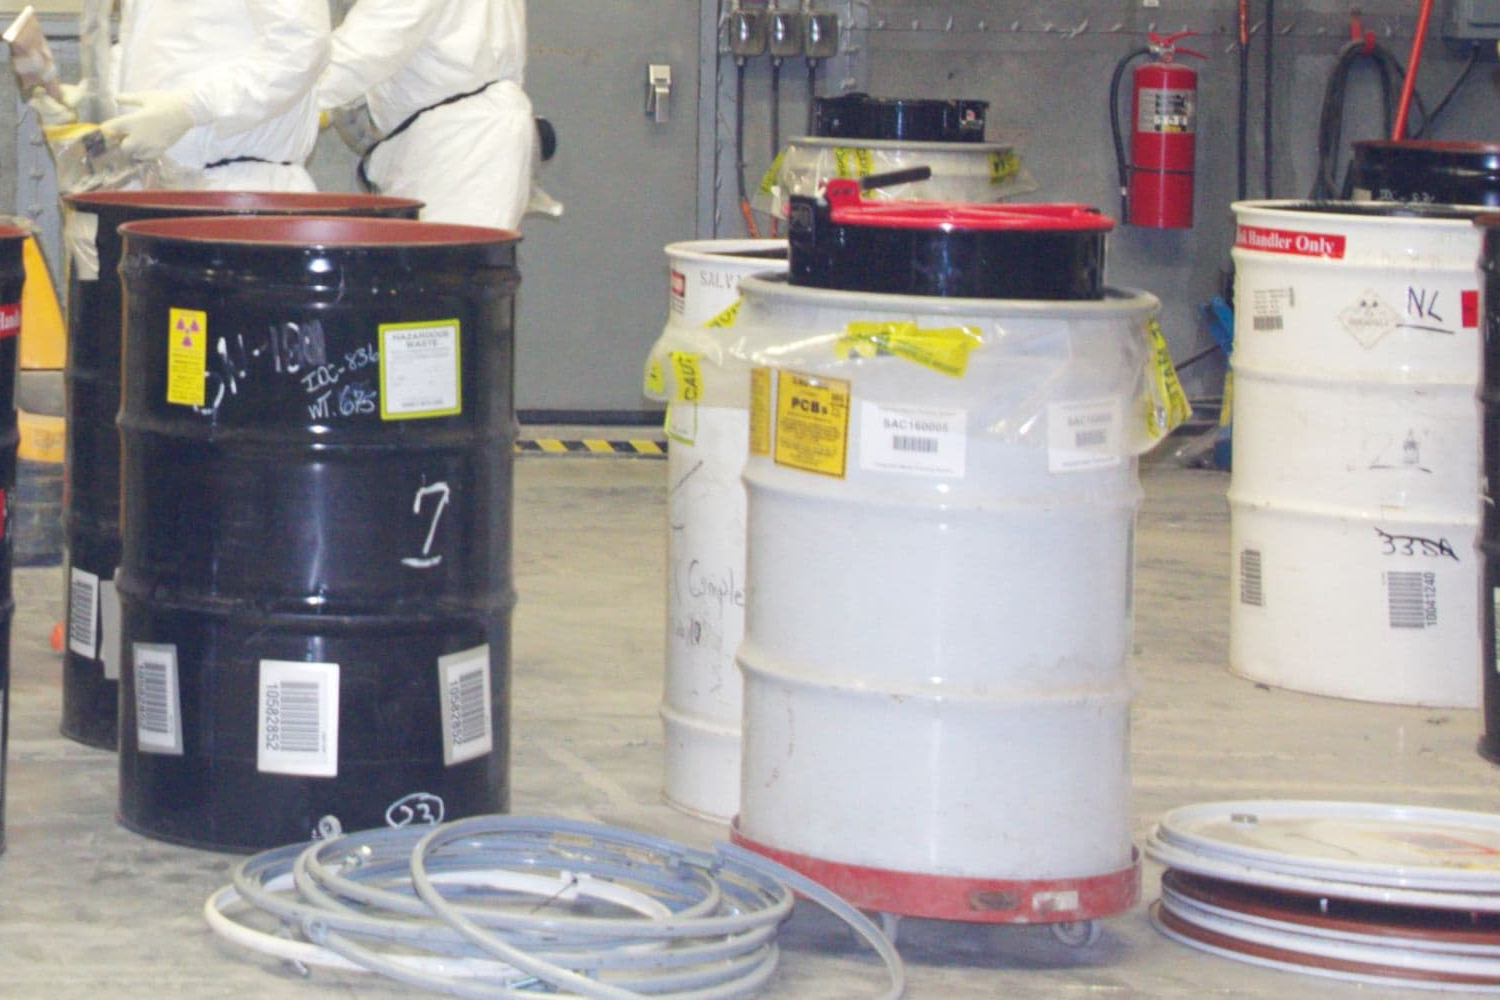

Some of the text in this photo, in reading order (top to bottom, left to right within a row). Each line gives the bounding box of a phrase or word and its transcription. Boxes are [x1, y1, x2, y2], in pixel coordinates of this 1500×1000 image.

[1248, 230, 1292, 248] Handler
[1295, 234, 1335, 257] Only
[791, 396, 828, 415] PCBs
[414, 482, 450, 555] 7
[266, 684, 280, 751] 10582852
